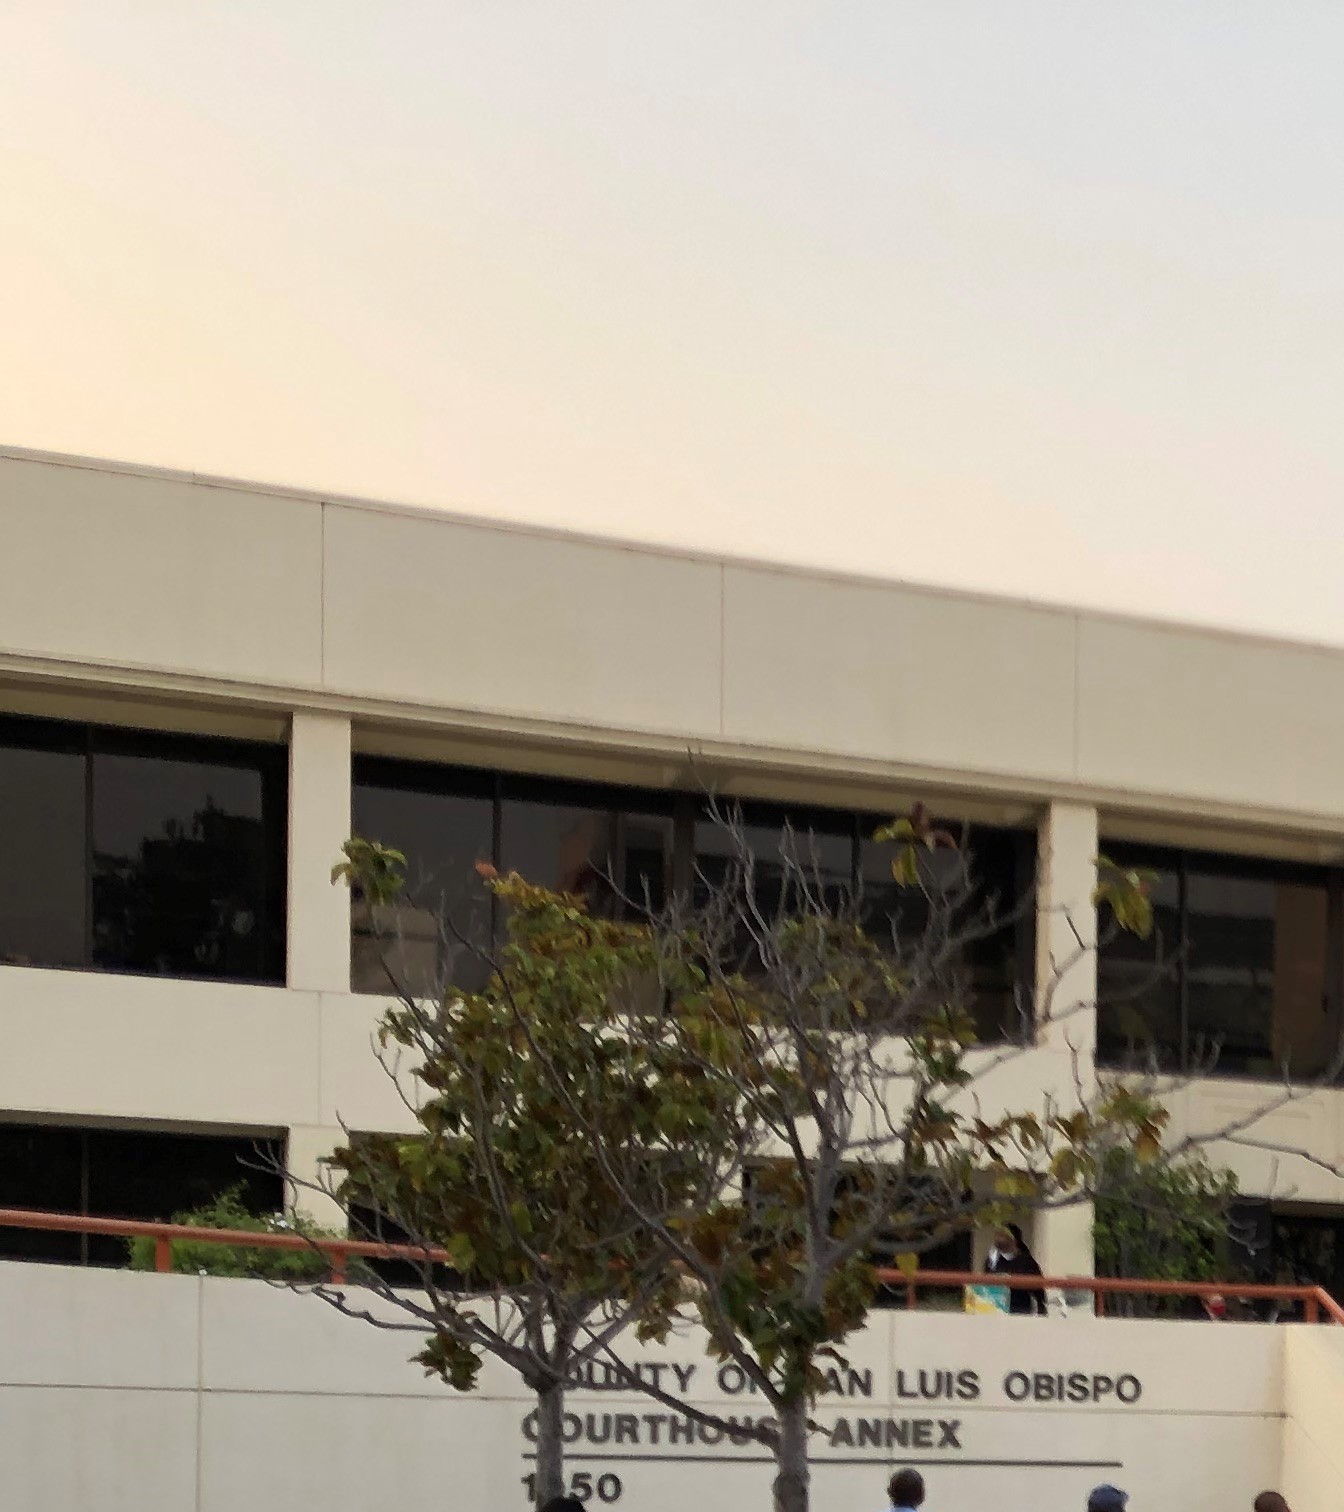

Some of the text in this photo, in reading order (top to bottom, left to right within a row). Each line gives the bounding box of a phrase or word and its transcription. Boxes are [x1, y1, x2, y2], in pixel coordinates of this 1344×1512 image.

[550, 1361, 697, 1393] OUNTY
[822, 1366, 872, 1397] AN
[896, 1368, 981, 1399] LUIS
[1004, 1371, 1142, 1404] OBISPO
[829, 1416, 962, 1449] ANNEX
[521, 1472, 623, 1503] 150
